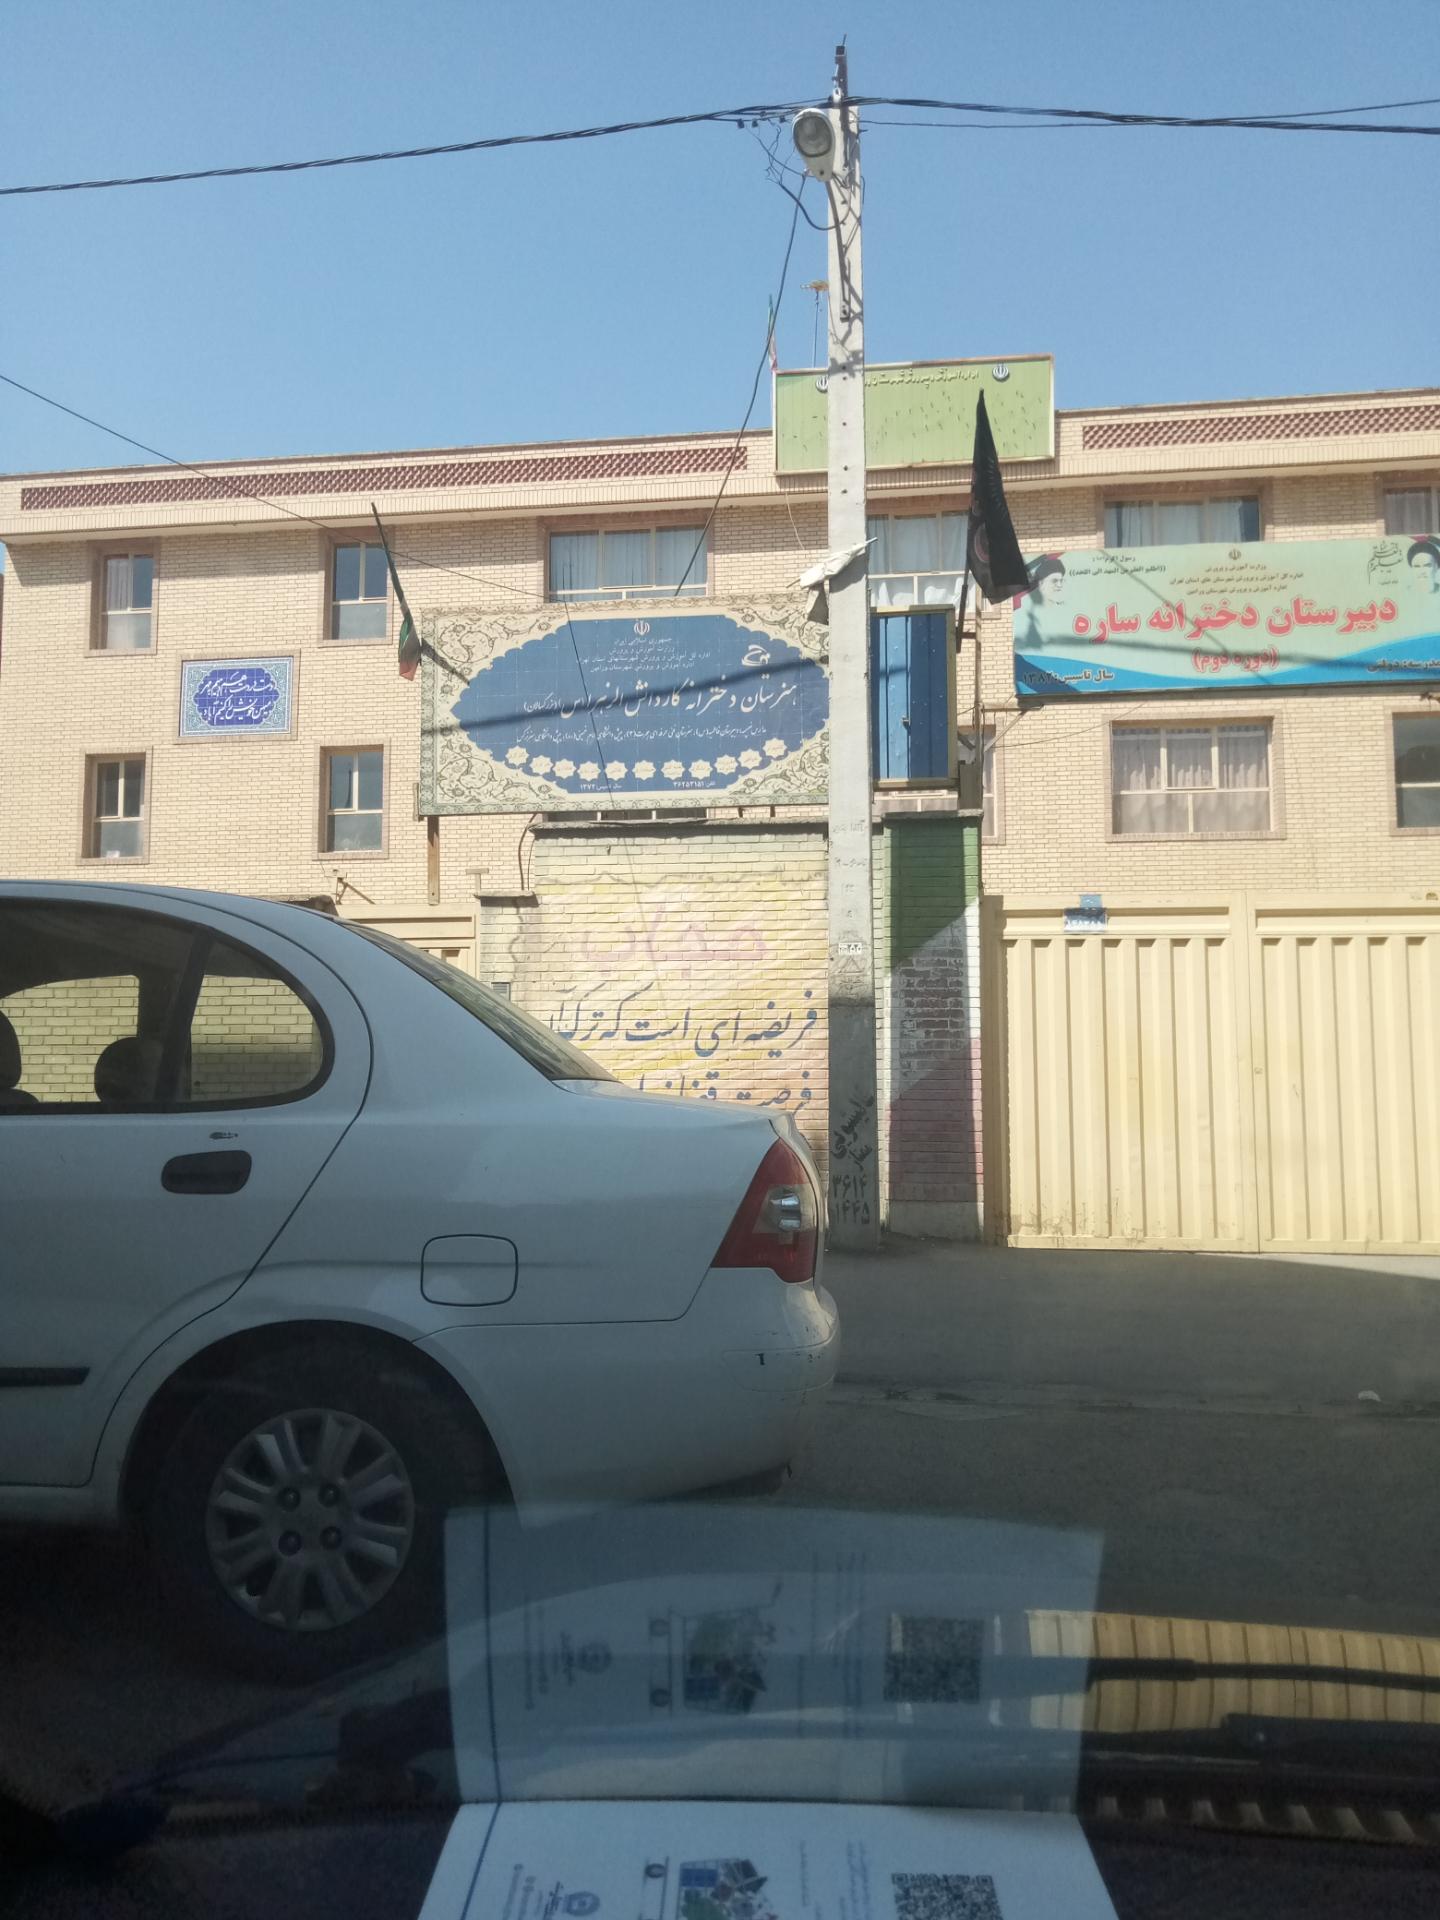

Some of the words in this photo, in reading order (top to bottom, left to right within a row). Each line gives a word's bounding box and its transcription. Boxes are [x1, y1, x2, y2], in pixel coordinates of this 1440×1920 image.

[1072, 603, 1142, 645] ساره
[1148, 598, 1260, 641] دخترانه
[1266, 596, 1398, 636] دبیرستان
[1094, 666, 1115, 684] سال
[1192, 649, 1230, 672] دوم)
[1232, 647, 1280, 672] (دوره
[685, 673, 737, 716] دخترانه
[740, 673, 798, 713] هنرستان
[600, 981, 655, 1040] که
[625, 1006, 691, 1041] است
[743, 990, 817, 1058] فریضه
[694, 1011, 741, 1058] ای
